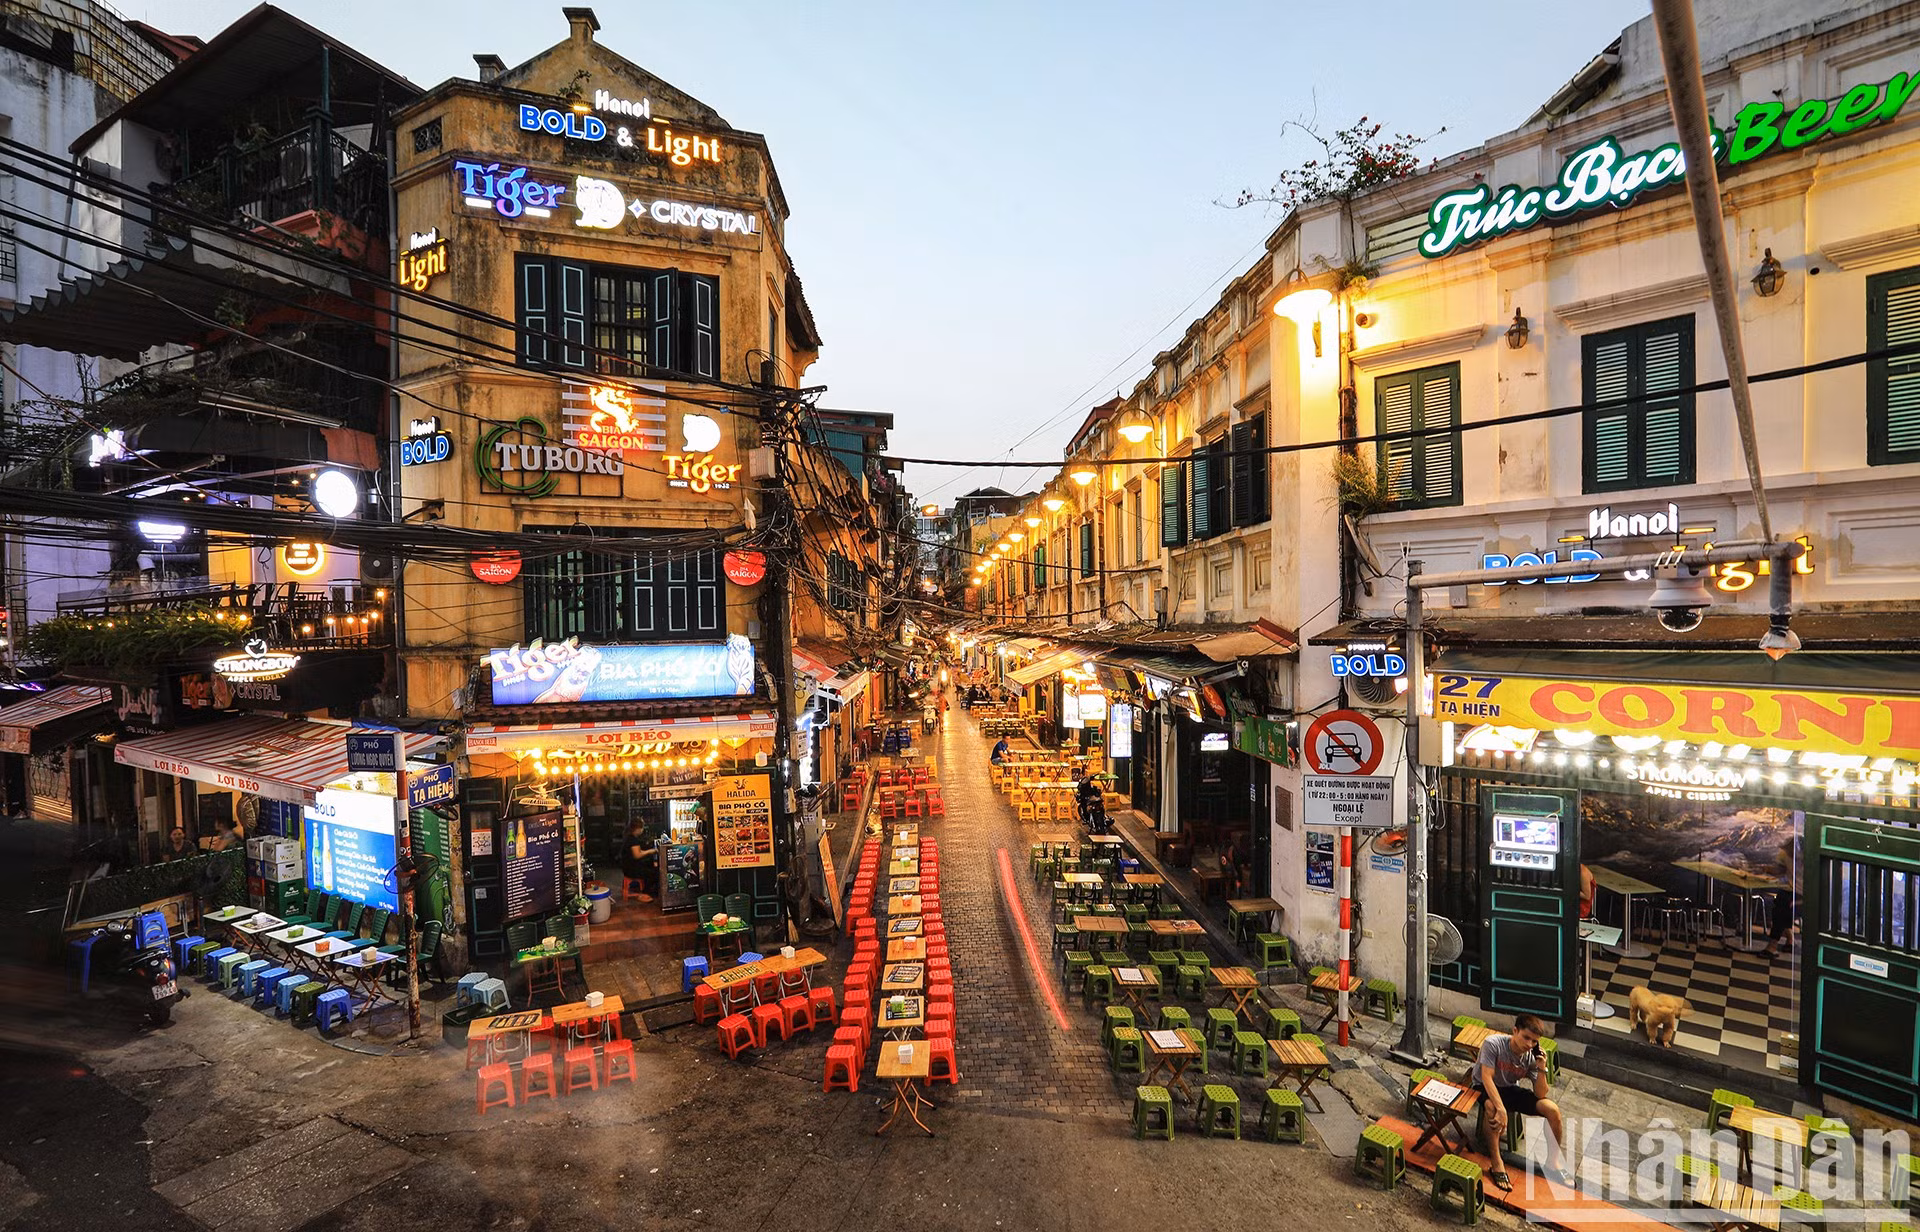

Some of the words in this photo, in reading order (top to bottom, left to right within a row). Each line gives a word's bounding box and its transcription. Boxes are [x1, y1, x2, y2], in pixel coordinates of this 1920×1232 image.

[595, 88, 650, 120] Hanoi
[520, 104, 607, 142] BOLD
[617, 126, 634, 147] &
[647, 127, 720, 166] Light
[1424, 186, 1539, 254] Trúc
[1728, 71, 1920, 165] Beer
[454, 161, 566, 218] Tiger
[650, 200, 761, 236] CRYSTAL
[400, 245, 447, 291] Light
[602, 425, 621, 434] BIA
[579, 433, 644, 450] SAIGON
[401, 435, 449, 466] BOLD
[495, 442, 624, 476] TUBORG
[662, 453, 742, 493] Tiger
[1589, 502, 1679, 539] Hanoi
[480, 568, 512, 576] SAIGON
[730, 570, 758, 578] SAIGON
[213, 656, 300, 673] STRONGBOW
[480, 634, 581, 682] Tiger
[1330, 653, 1405, 676] BOLD
[255, 673, 286, 682] CIDERS
[600, 663, 637, 680] BIA
[236, 682, 281, 701] CRYSTAL
[1439, 675, 1502, 698] 27
[1440, 700, 1458, 716] TẠ
[1463, 701, 1500, 718] HIỆN
[629, 728, 671, 742] BÉO
[363, 739, 379, 749] PHỐ
[171, 762, 190, 775] BÉO
[423, 770, 439, 784] PHỐ
[1626, 764, 1746, 789] STRONGBOW
[239, 778, 260, 792] BÉO
[413, 788, 426, 803] TẠ
[427, 781, 449, 799] HIỆN
[1307, 780, 1313, 788] XE
[1362, 781, 1374, 791] HOẠT
[1645, 785, 1682, 799] APPLE
[1686, 791, 1731, 801] CIDERS
[727, 790, 756, 798] HALIDA
[314, 803, 336, 817] BOLD
[734, 801, 751, 809] PHỐ
[754, 800, 766, 808] CỔ
[1333, 803, 1354, 814] NGOẠI
[1356, 803, 1364, 814] LỆ
[1335, 814, 1362, 823] Except
